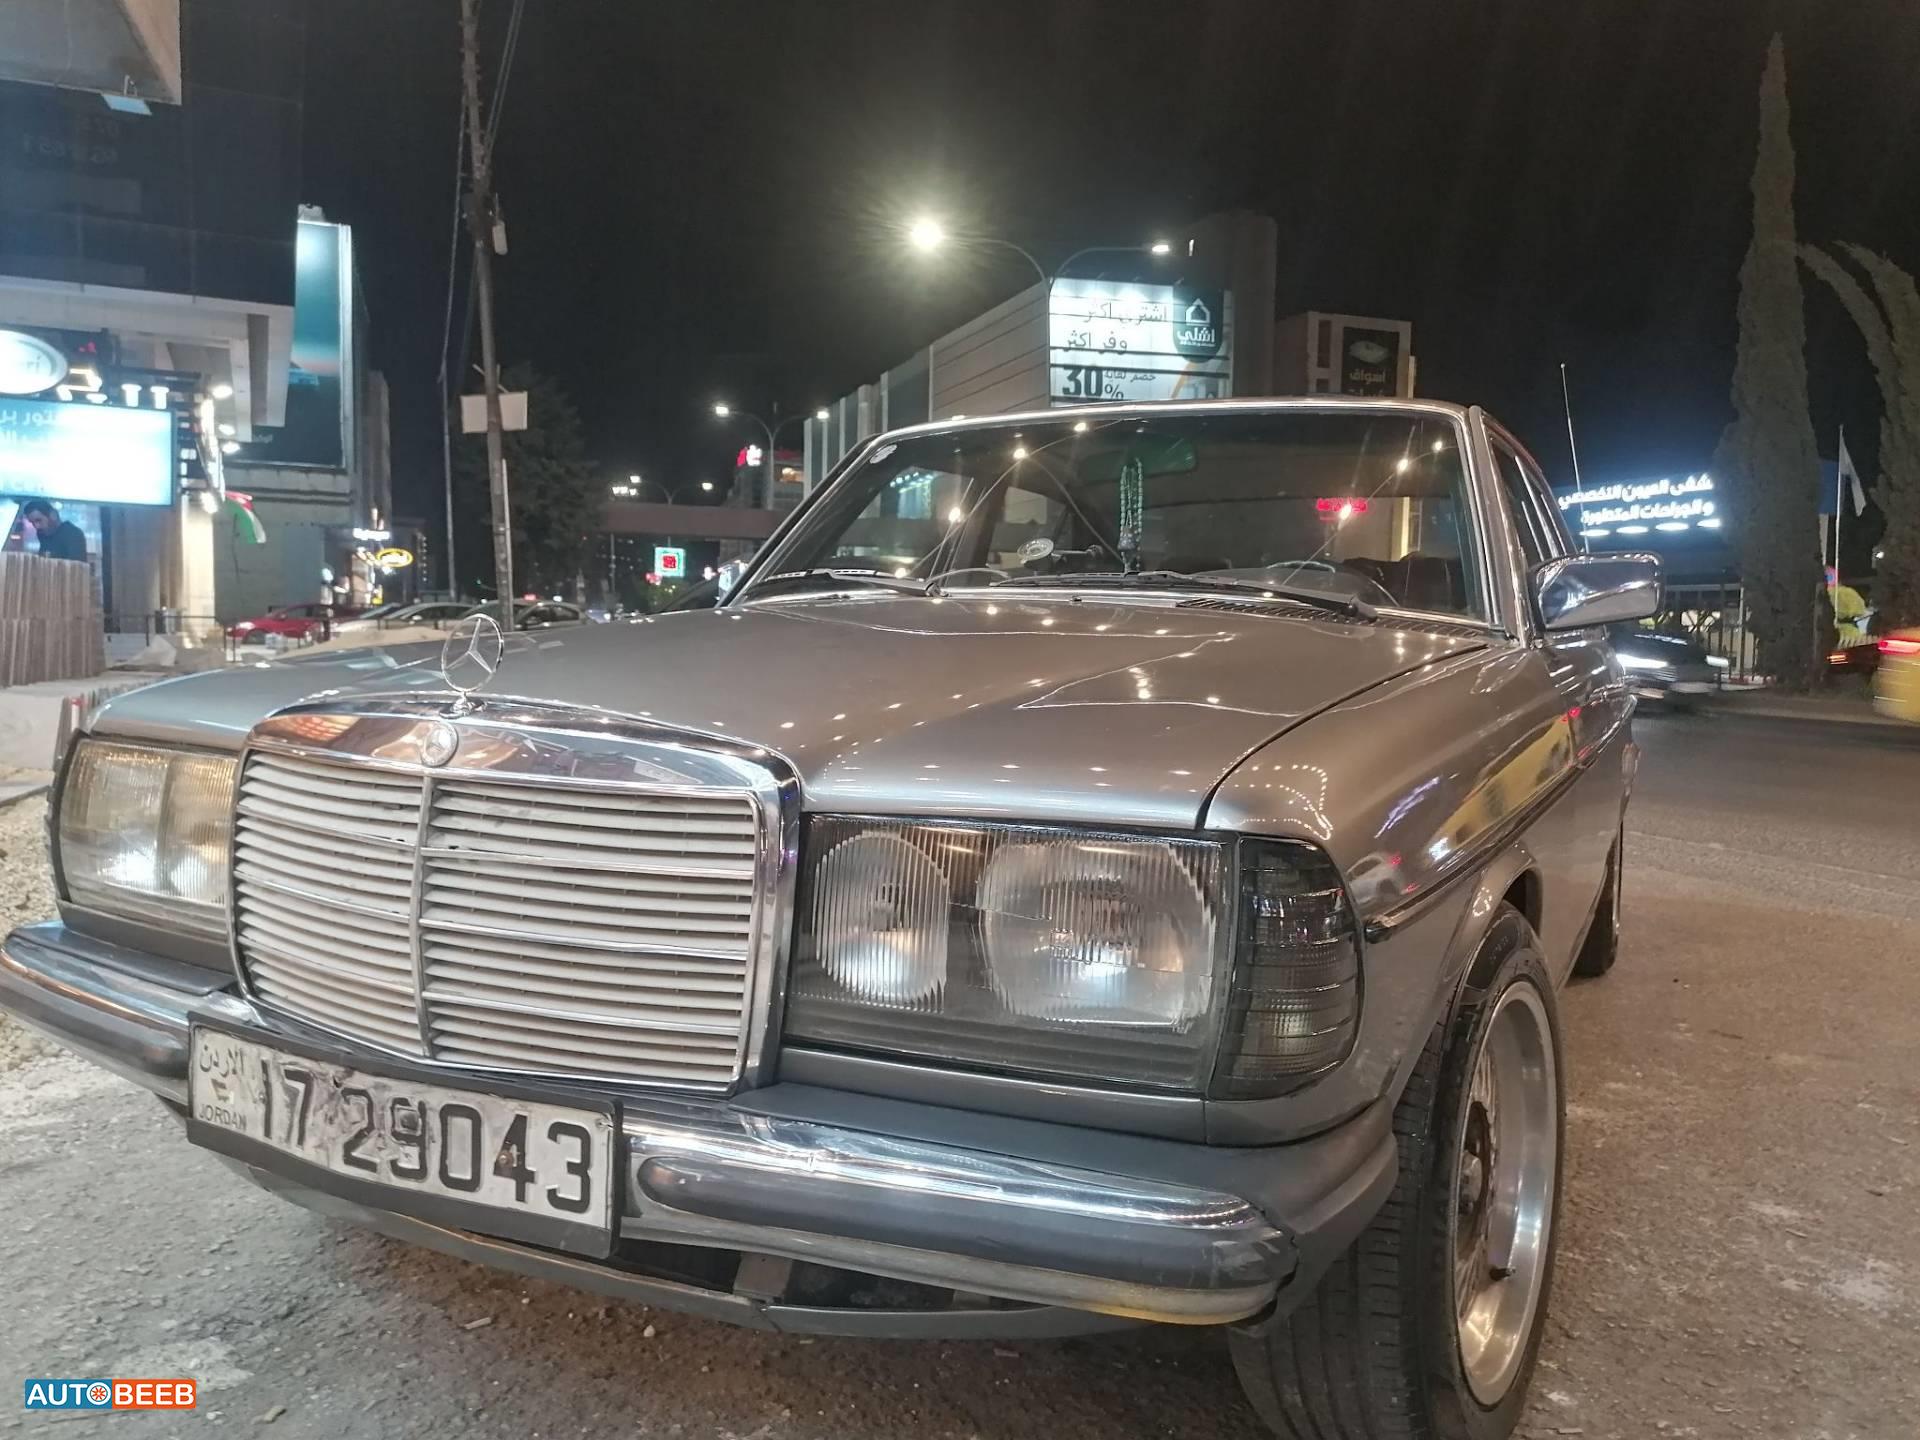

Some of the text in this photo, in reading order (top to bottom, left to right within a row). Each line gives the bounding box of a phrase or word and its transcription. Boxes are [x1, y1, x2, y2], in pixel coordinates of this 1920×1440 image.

[1177, 327, 1216, 343] اشلي
[1622, 478, 1670, 502] العيون
[198, 1103, 247, 1131] JORDAN
